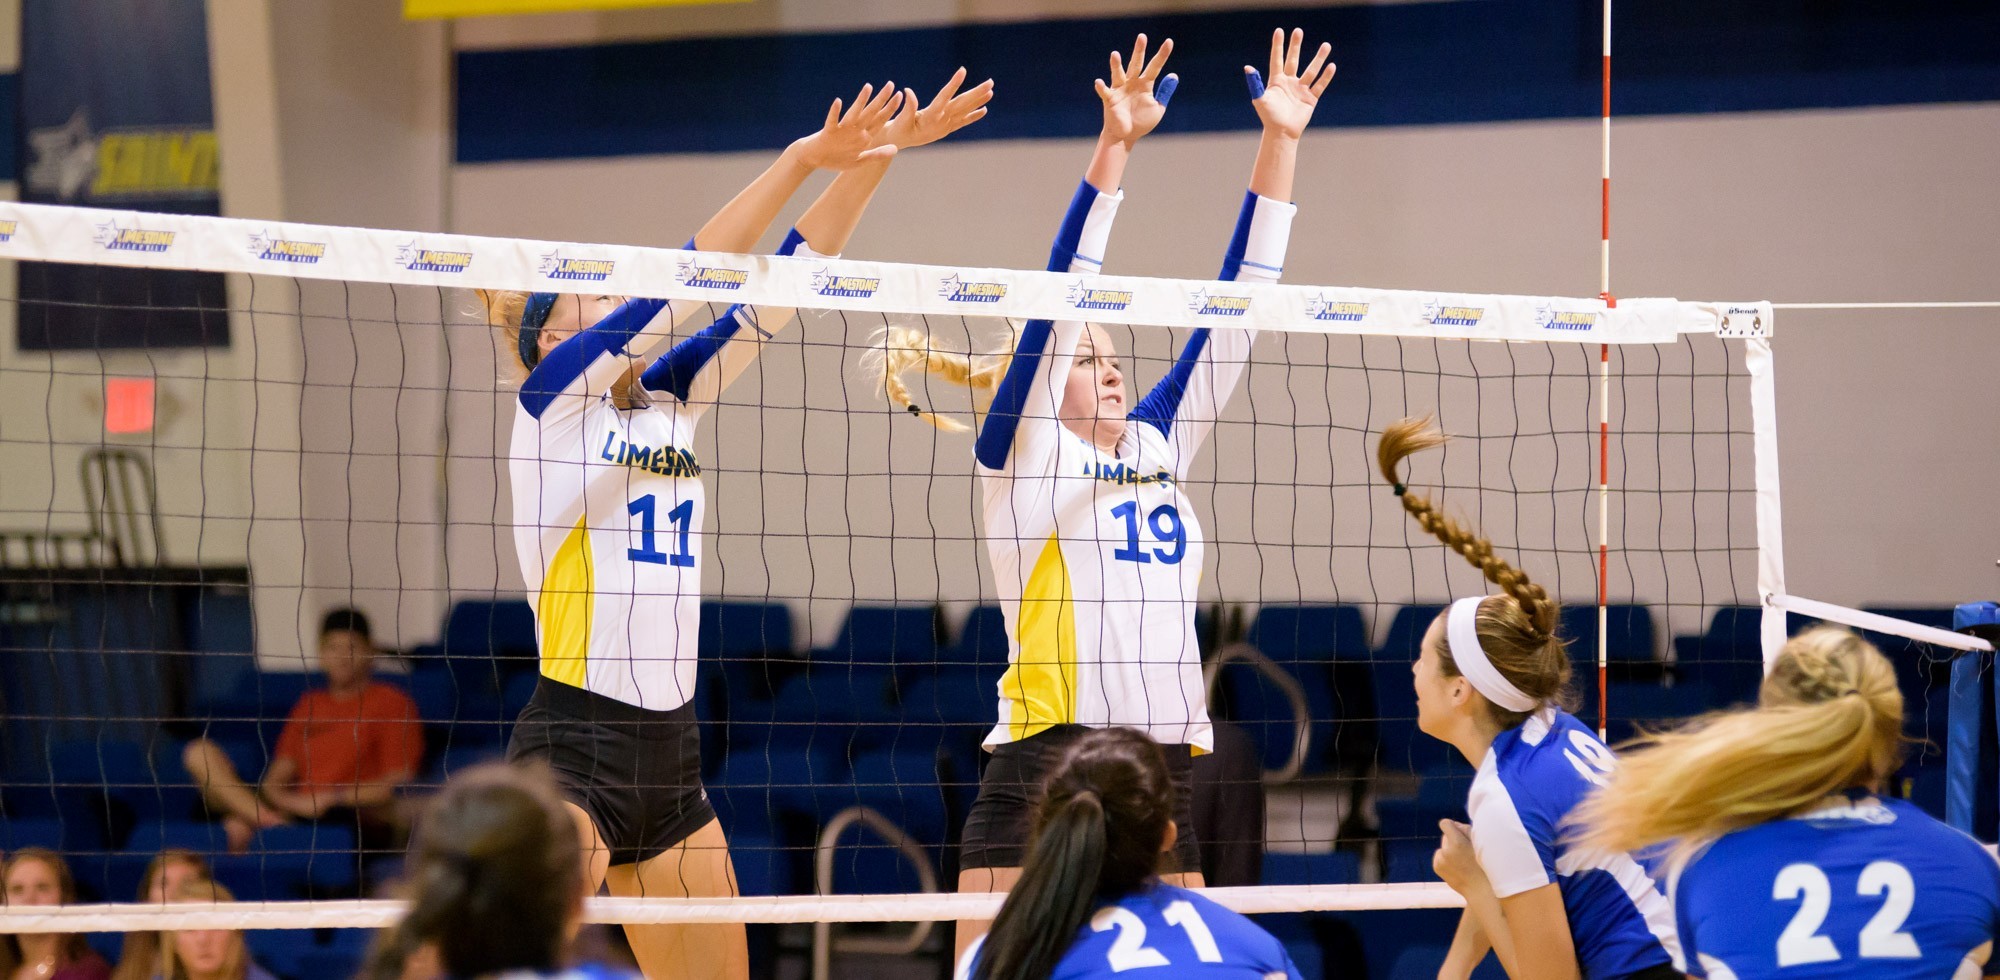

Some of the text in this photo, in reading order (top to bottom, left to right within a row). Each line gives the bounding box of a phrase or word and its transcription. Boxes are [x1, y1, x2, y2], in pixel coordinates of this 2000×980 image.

[270, 240, 326, 258] LIMESTONE
[416, 250, 473, 267] LIMESTONE
[558, 259, 615, 275] LIMESTONE
[696, 267, 748, 284] LIMESTONE
[829, 276, 880, 292] LIMESTONE
[959, 282, 1007, 298] LIMESTONE
[1084, 289, 1133, 305] LIMESTONE
[1207, 296, 1252, 311] LIMESTONE
[1324, 302, 1370, 316] LIMESTONE
[1438, 307, 1484, 321] LIMESTONE
[627, 493, 695, 567] 11
[1110, 501, 1187, 565] 19
[1772, 861, 1922, 967] 22
[1090, 900, 1223, 973] 21
